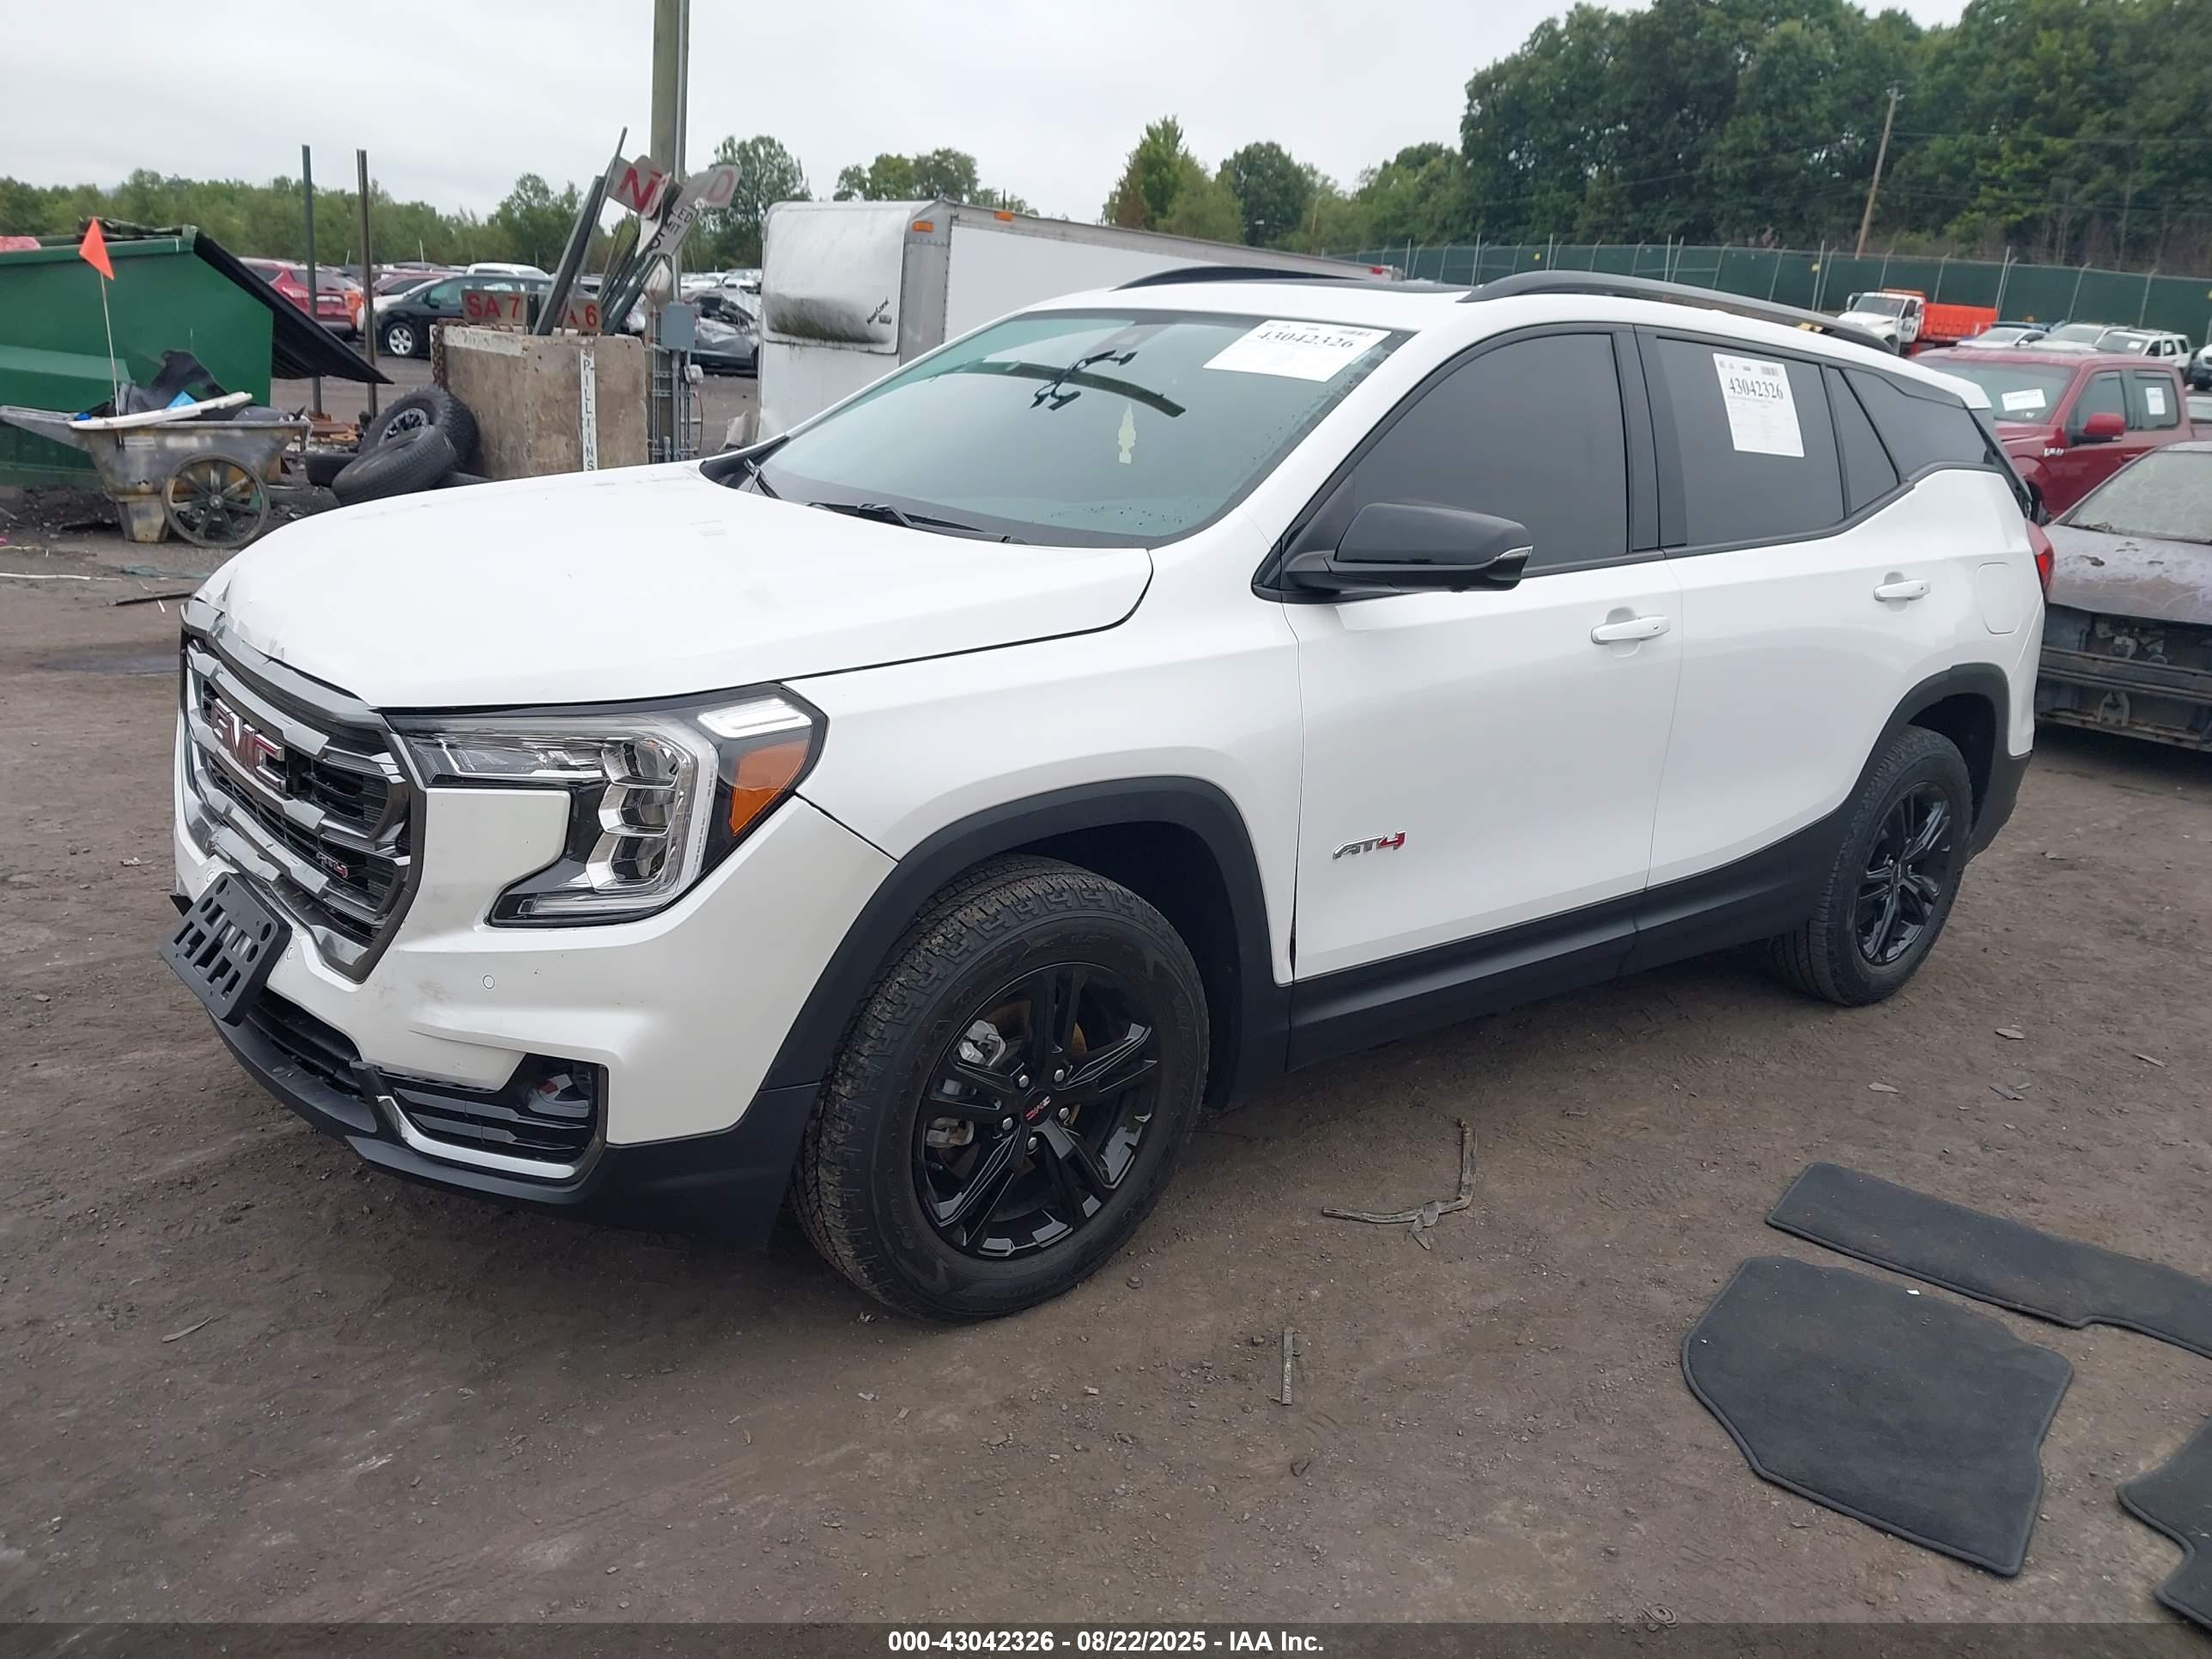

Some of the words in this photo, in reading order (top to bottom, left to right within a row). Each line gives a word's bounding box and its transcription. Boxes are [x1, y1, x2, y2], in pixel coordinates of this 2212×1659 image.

[466, 293, 501, 319] SA
[508, 294, 520, 319] 7
[585, 303, 598, 328] 6
[1729, 377, 1784, 400] 43042326
[1332, 830, 1407, 860] AT4
